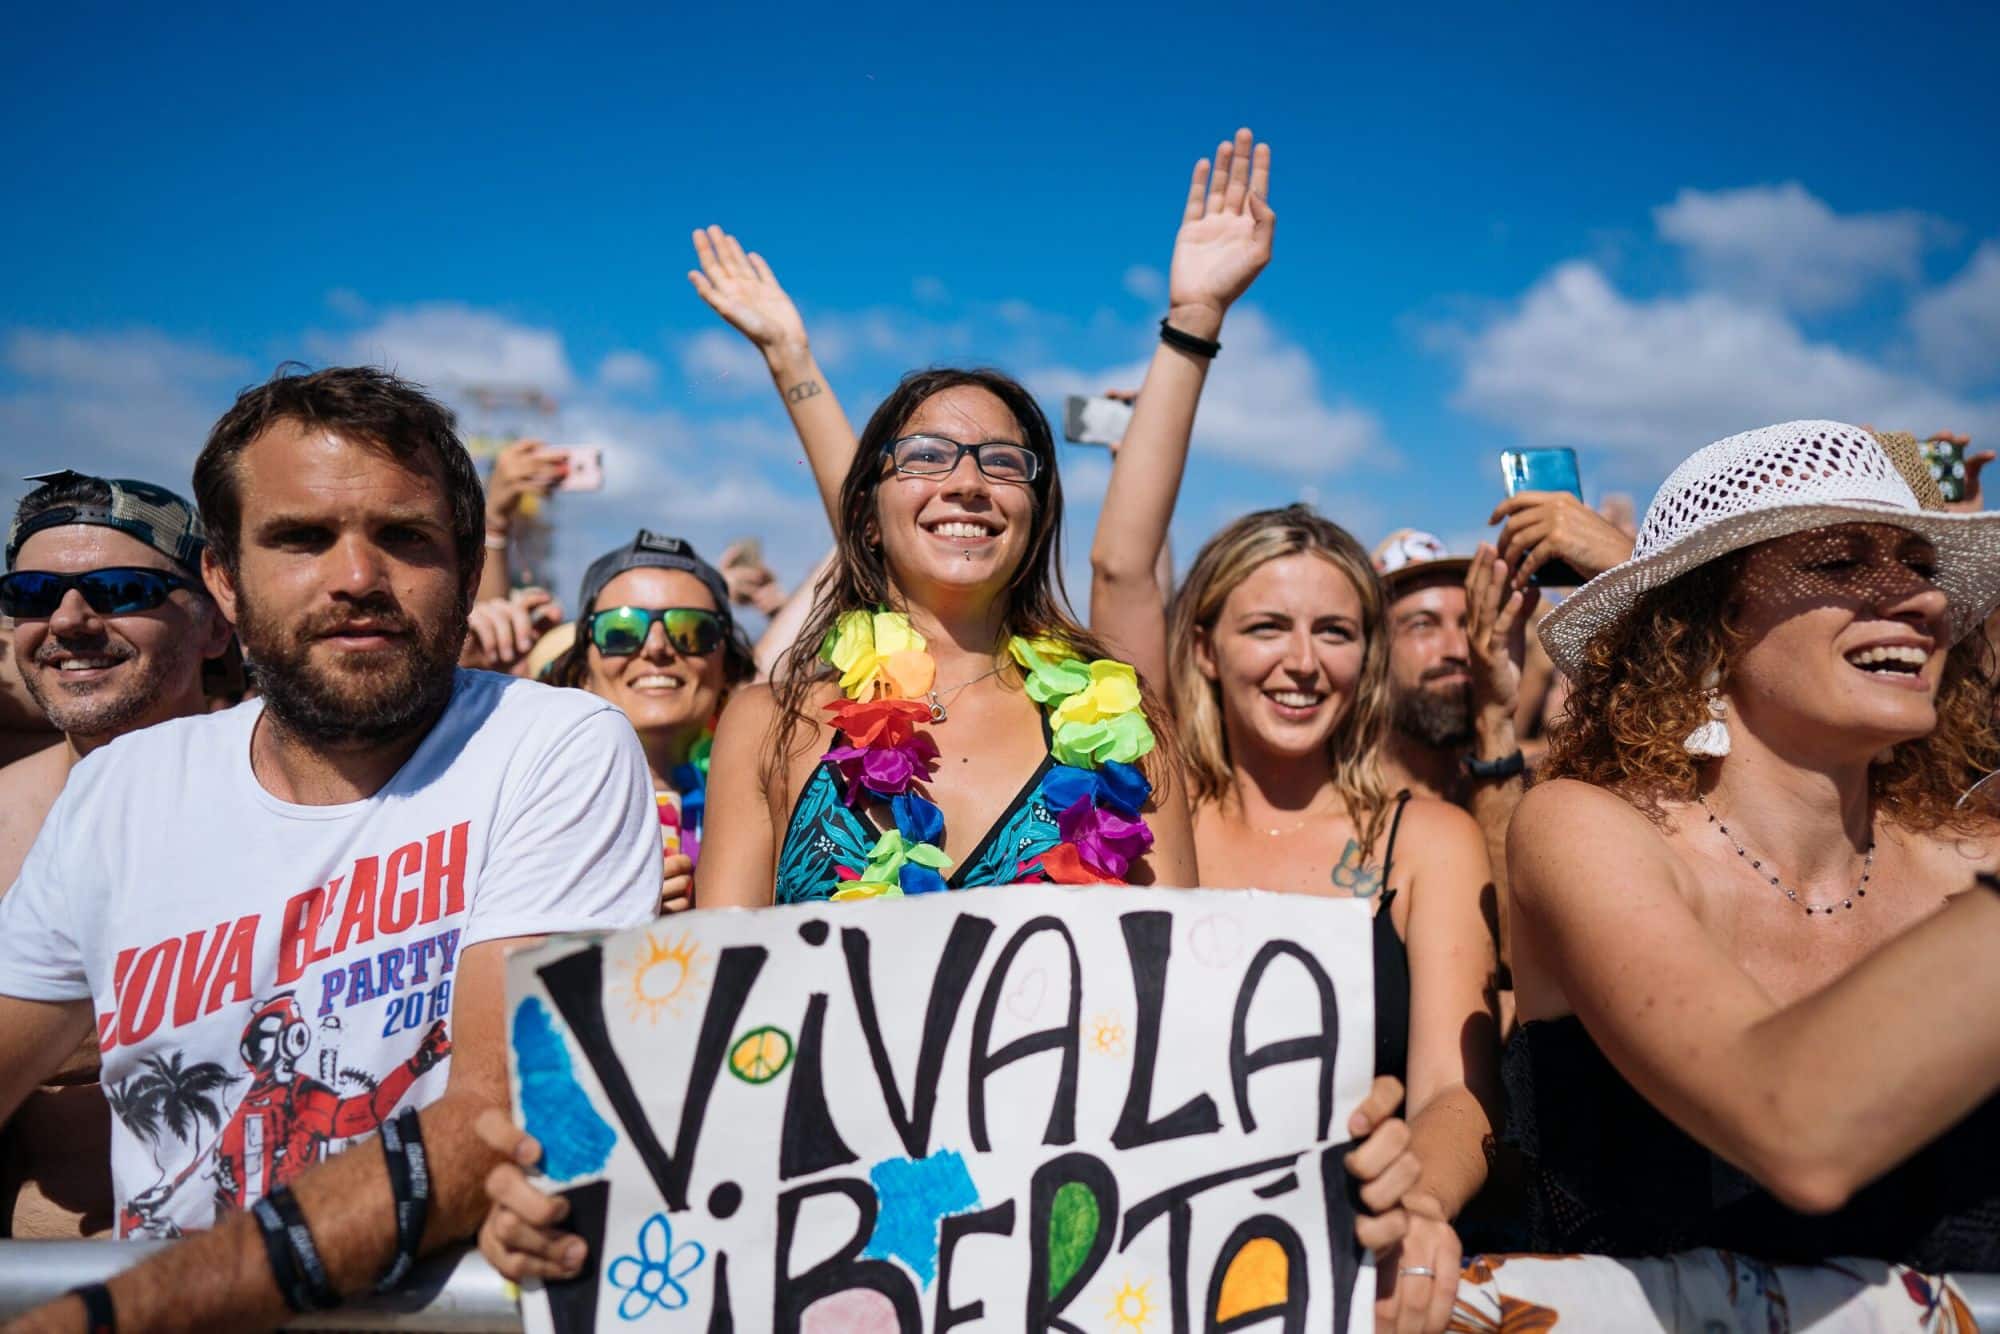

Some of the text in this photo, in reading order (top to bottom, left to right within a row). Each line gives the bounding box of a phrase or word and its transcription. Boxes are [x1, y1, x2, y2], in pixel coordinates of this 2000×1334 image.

[98, 819, 471, 1054] JOVA BEACH
[317, 927, 461, 1018] PARTY
[382, 979, 451, 1038] 2019
